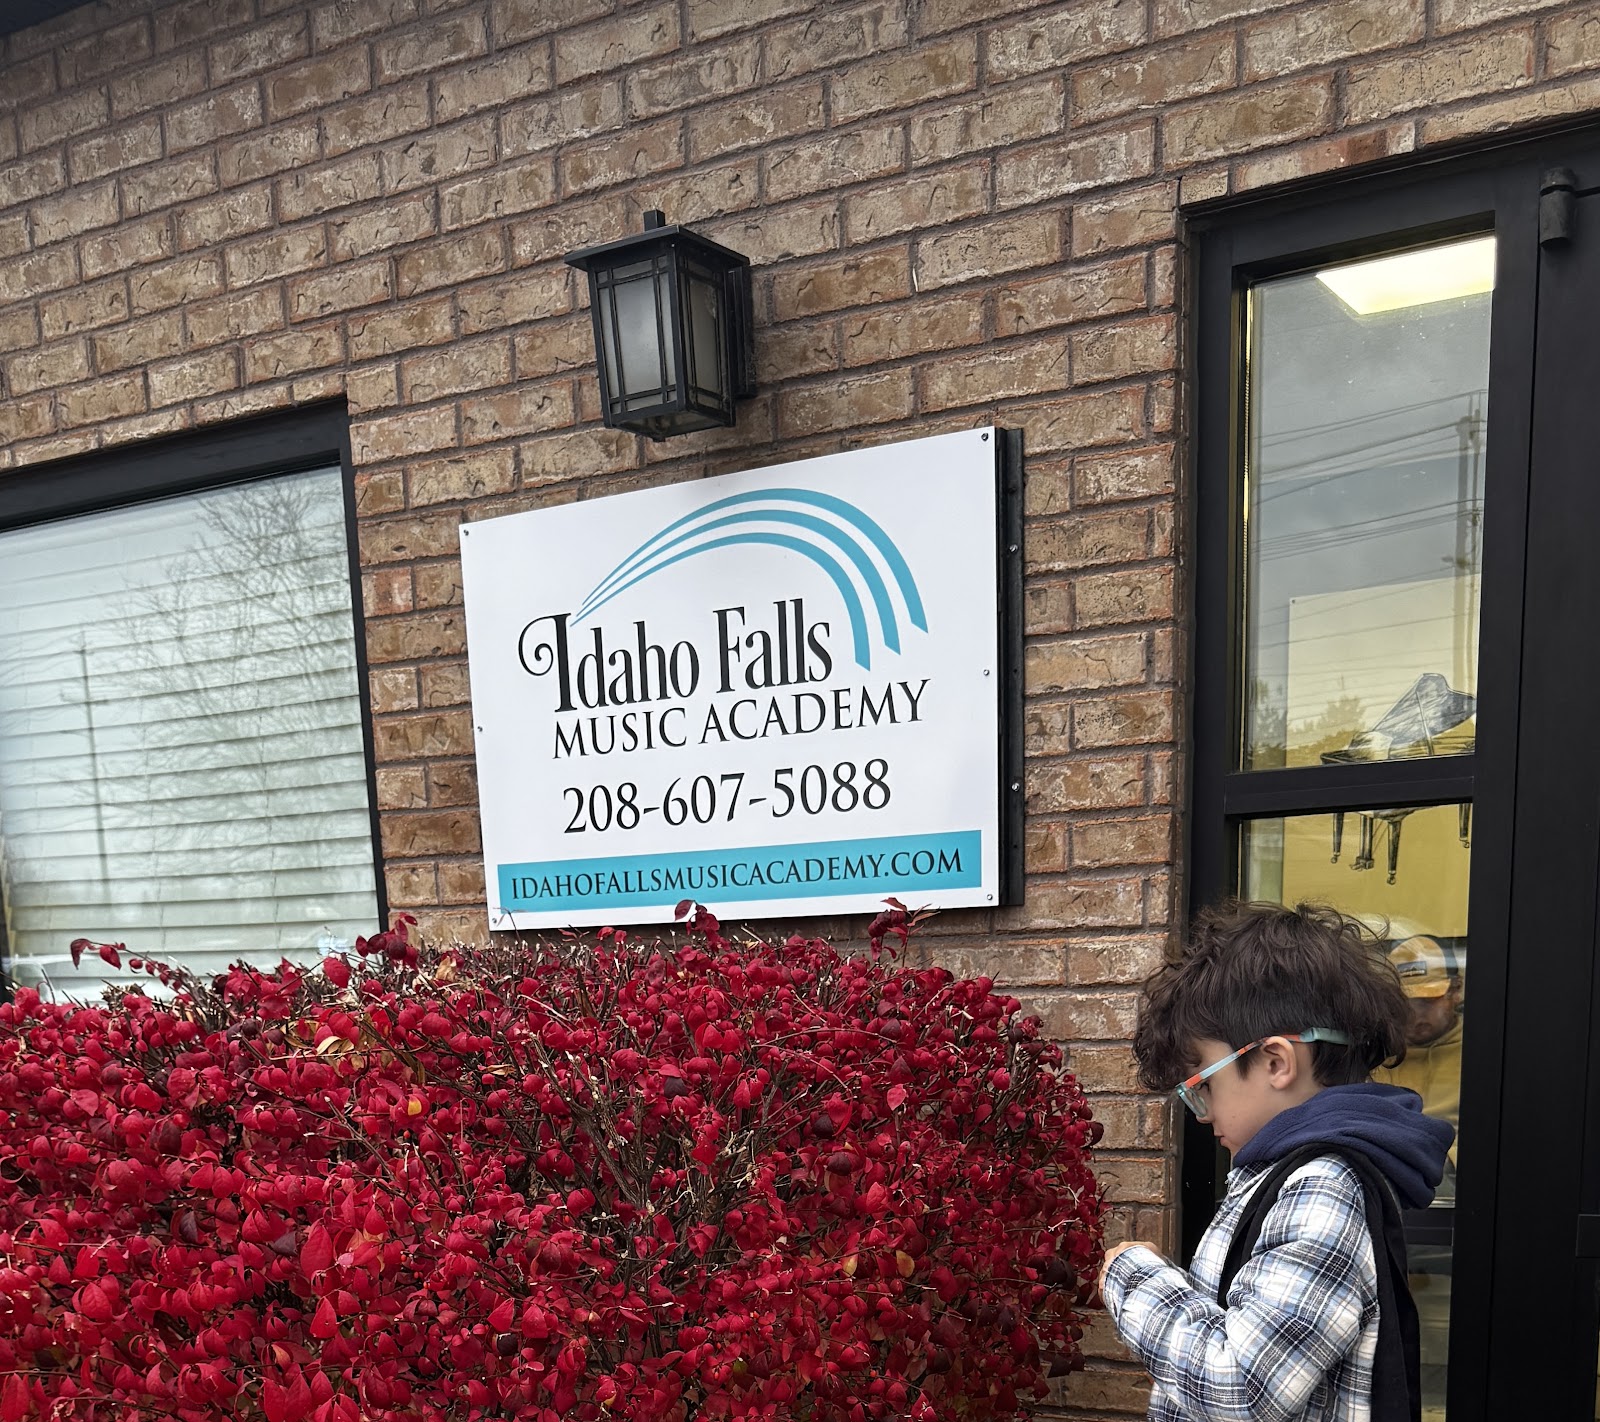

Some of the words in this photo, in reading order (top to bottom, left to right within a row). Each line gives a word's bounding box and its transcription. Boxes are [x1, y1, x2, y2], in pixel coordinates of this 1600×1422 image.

[518, 612, 700, 713] Idaho
[712, 597, 833, 694] Falls
[552, 707, 688, 760] MUSIC
[700, 678, 931, 745] ACADEMY
[562, 758, 892, 835] 208-607-5088
[511, 848, 963, 900] IDAHOFALLSMUSICACADEMY.COM
